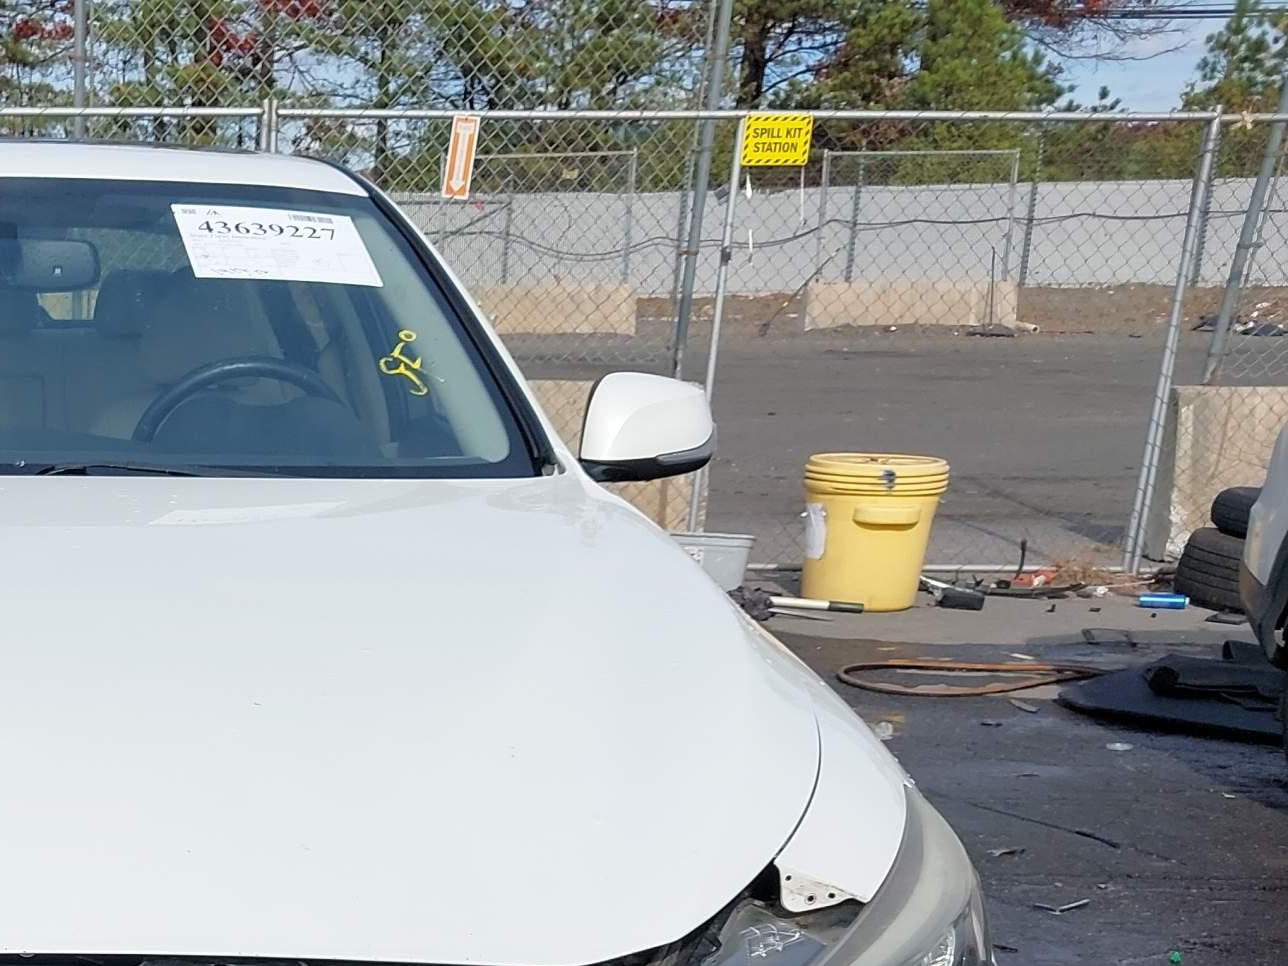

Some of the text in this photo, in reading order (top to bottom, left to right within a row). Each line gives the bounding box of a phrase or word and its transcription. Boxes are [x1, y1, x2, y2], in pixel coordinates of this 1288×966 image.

[752, 127, 803, 139] SPILL KIT
[753, 142, 798, 153] STATION
[198, 220, 336, 241] 43639227
